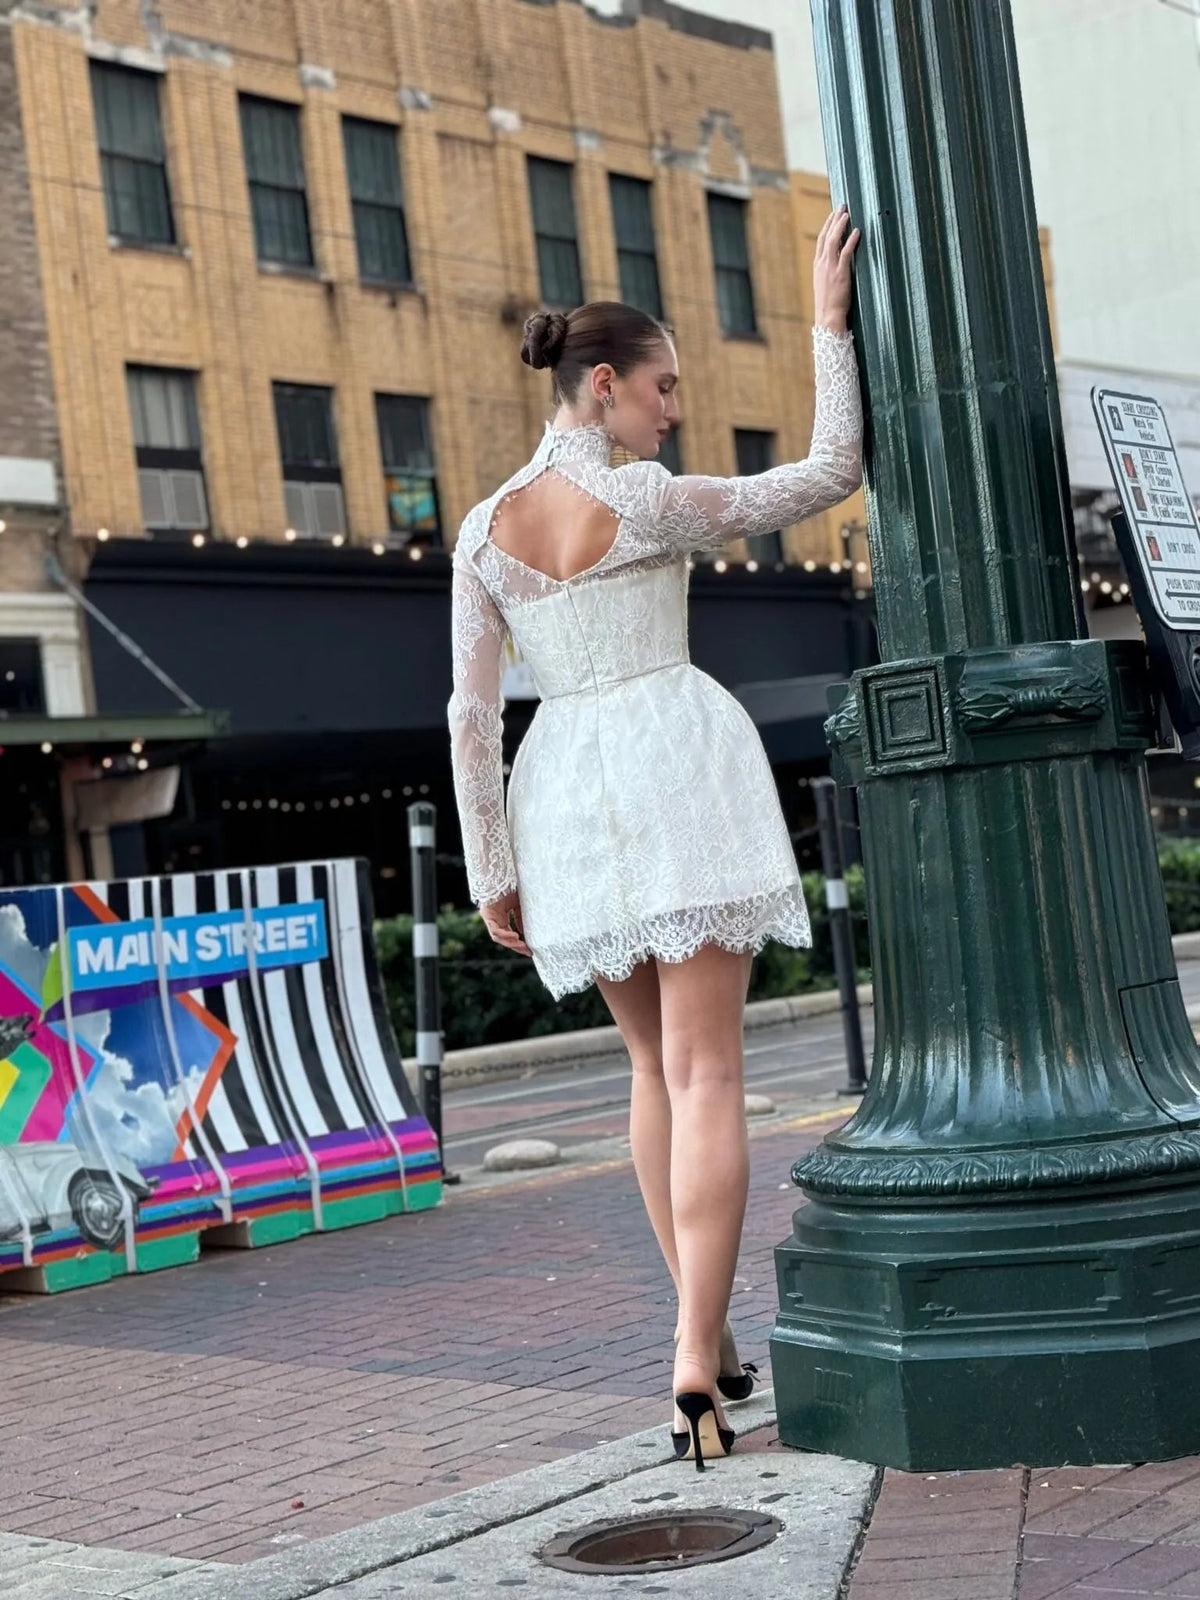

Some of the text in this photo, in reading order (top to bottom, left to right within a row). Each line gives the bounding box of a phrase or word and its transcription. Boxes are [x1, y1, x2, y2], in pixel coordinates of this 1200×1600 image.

[1166, 578, 1182, 590] PUSH
[1177, 599, 1187, 611] TO
[76, 913, 318, 976] MAIN STREET
